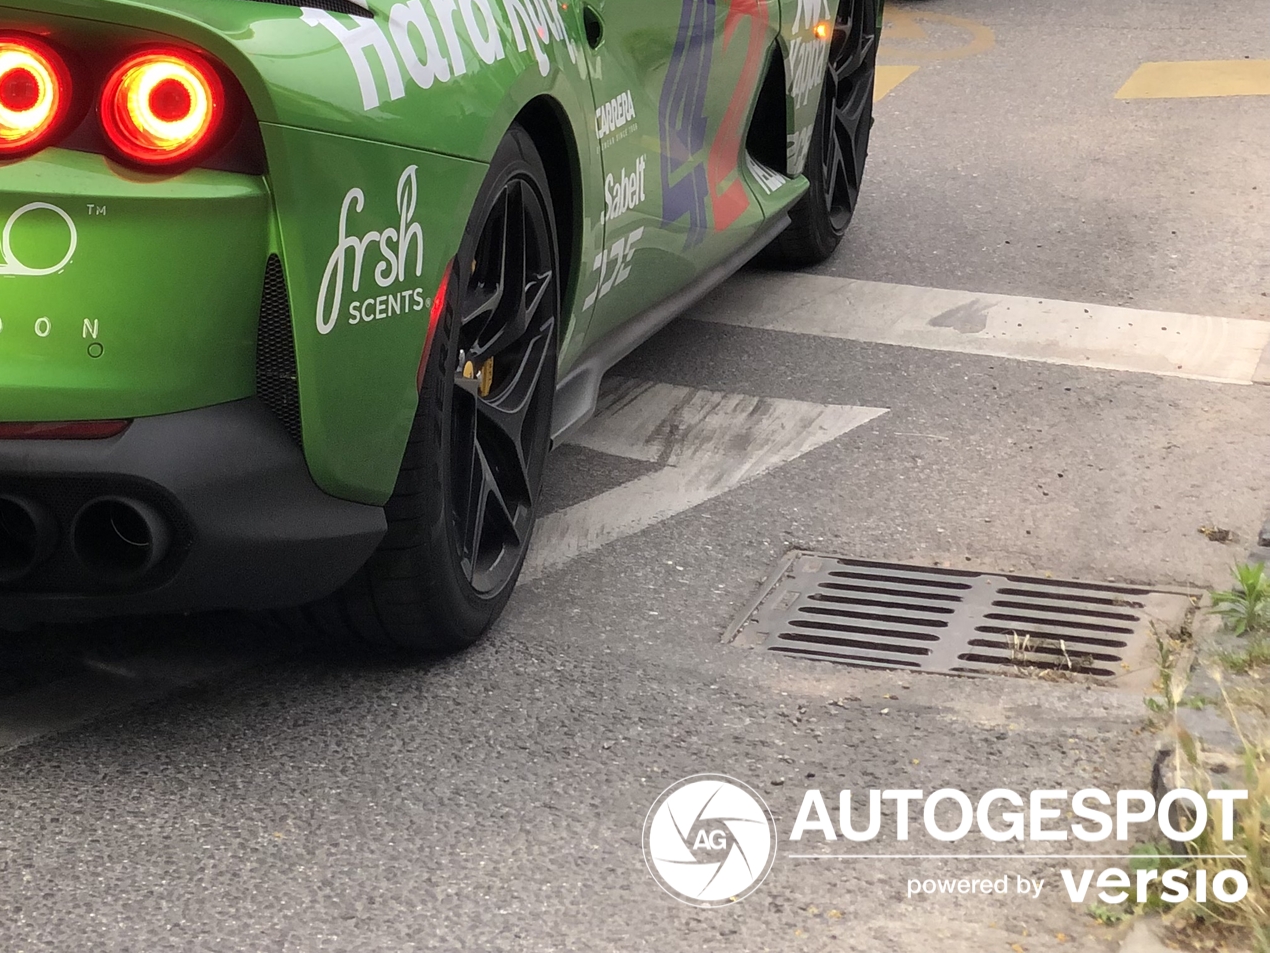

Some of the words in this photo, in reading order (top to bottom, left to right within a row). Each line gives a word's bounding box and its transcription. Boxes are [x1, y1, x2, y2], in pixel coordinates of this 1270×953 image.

[594, 89, 636, 140] CARRERA
[601, 158, 645, 225] Sabelt
[315, 164, 424, 335] frsh
